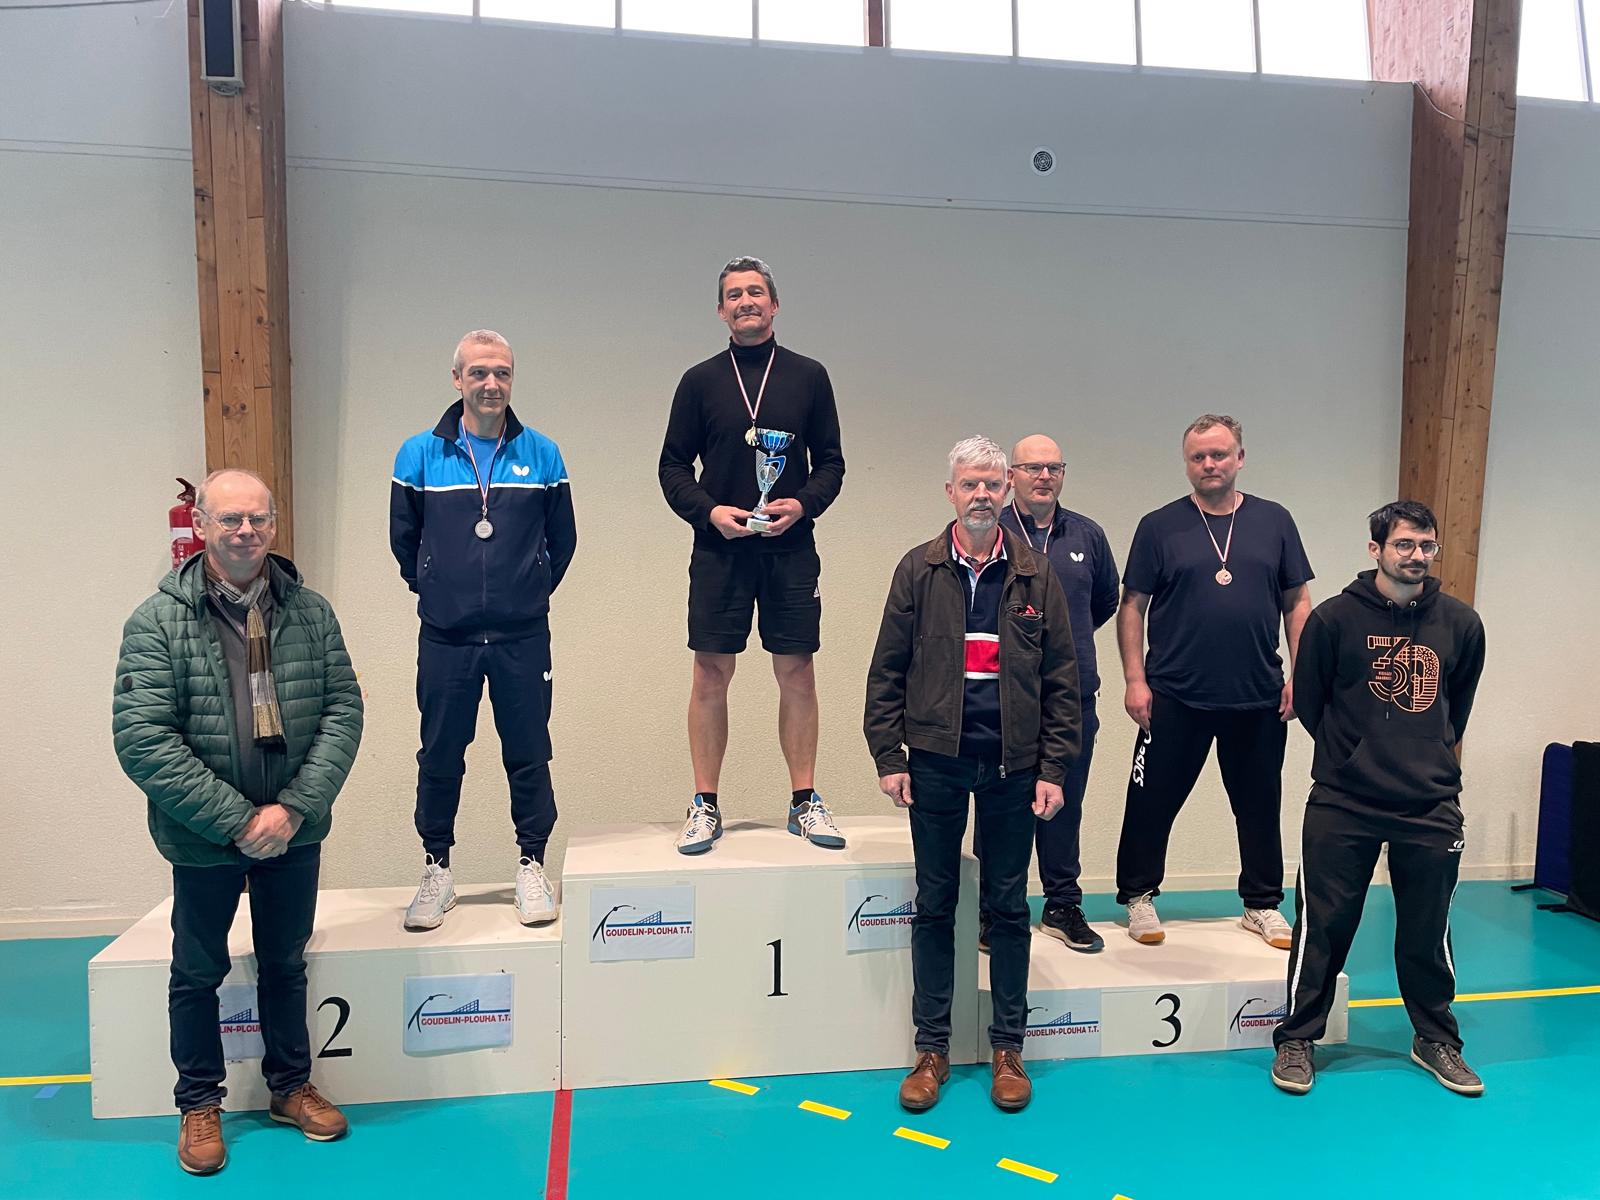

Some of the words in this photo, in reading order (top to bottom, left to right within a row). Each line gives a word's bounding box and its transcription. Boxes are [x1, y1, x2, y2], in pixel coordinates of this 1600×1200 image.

[860, 917, 913, 927] GOUDELIN-PLO
[606, 927, 678, 937] GOUDELIN-PLOUHA
[680, 926, 693, 935] T.T.
[766, 938, 789, 997] 1
[421, 1015, 496, 1026] GOUDELIN-PLOUHA
[498, 1014, 511, 1023] T.T.
[1151, 993, 1182, 1048] 3
[1241, 1019, 1278, 1028] GOUDELIN-
[316, 996, 353, 1059] 2
